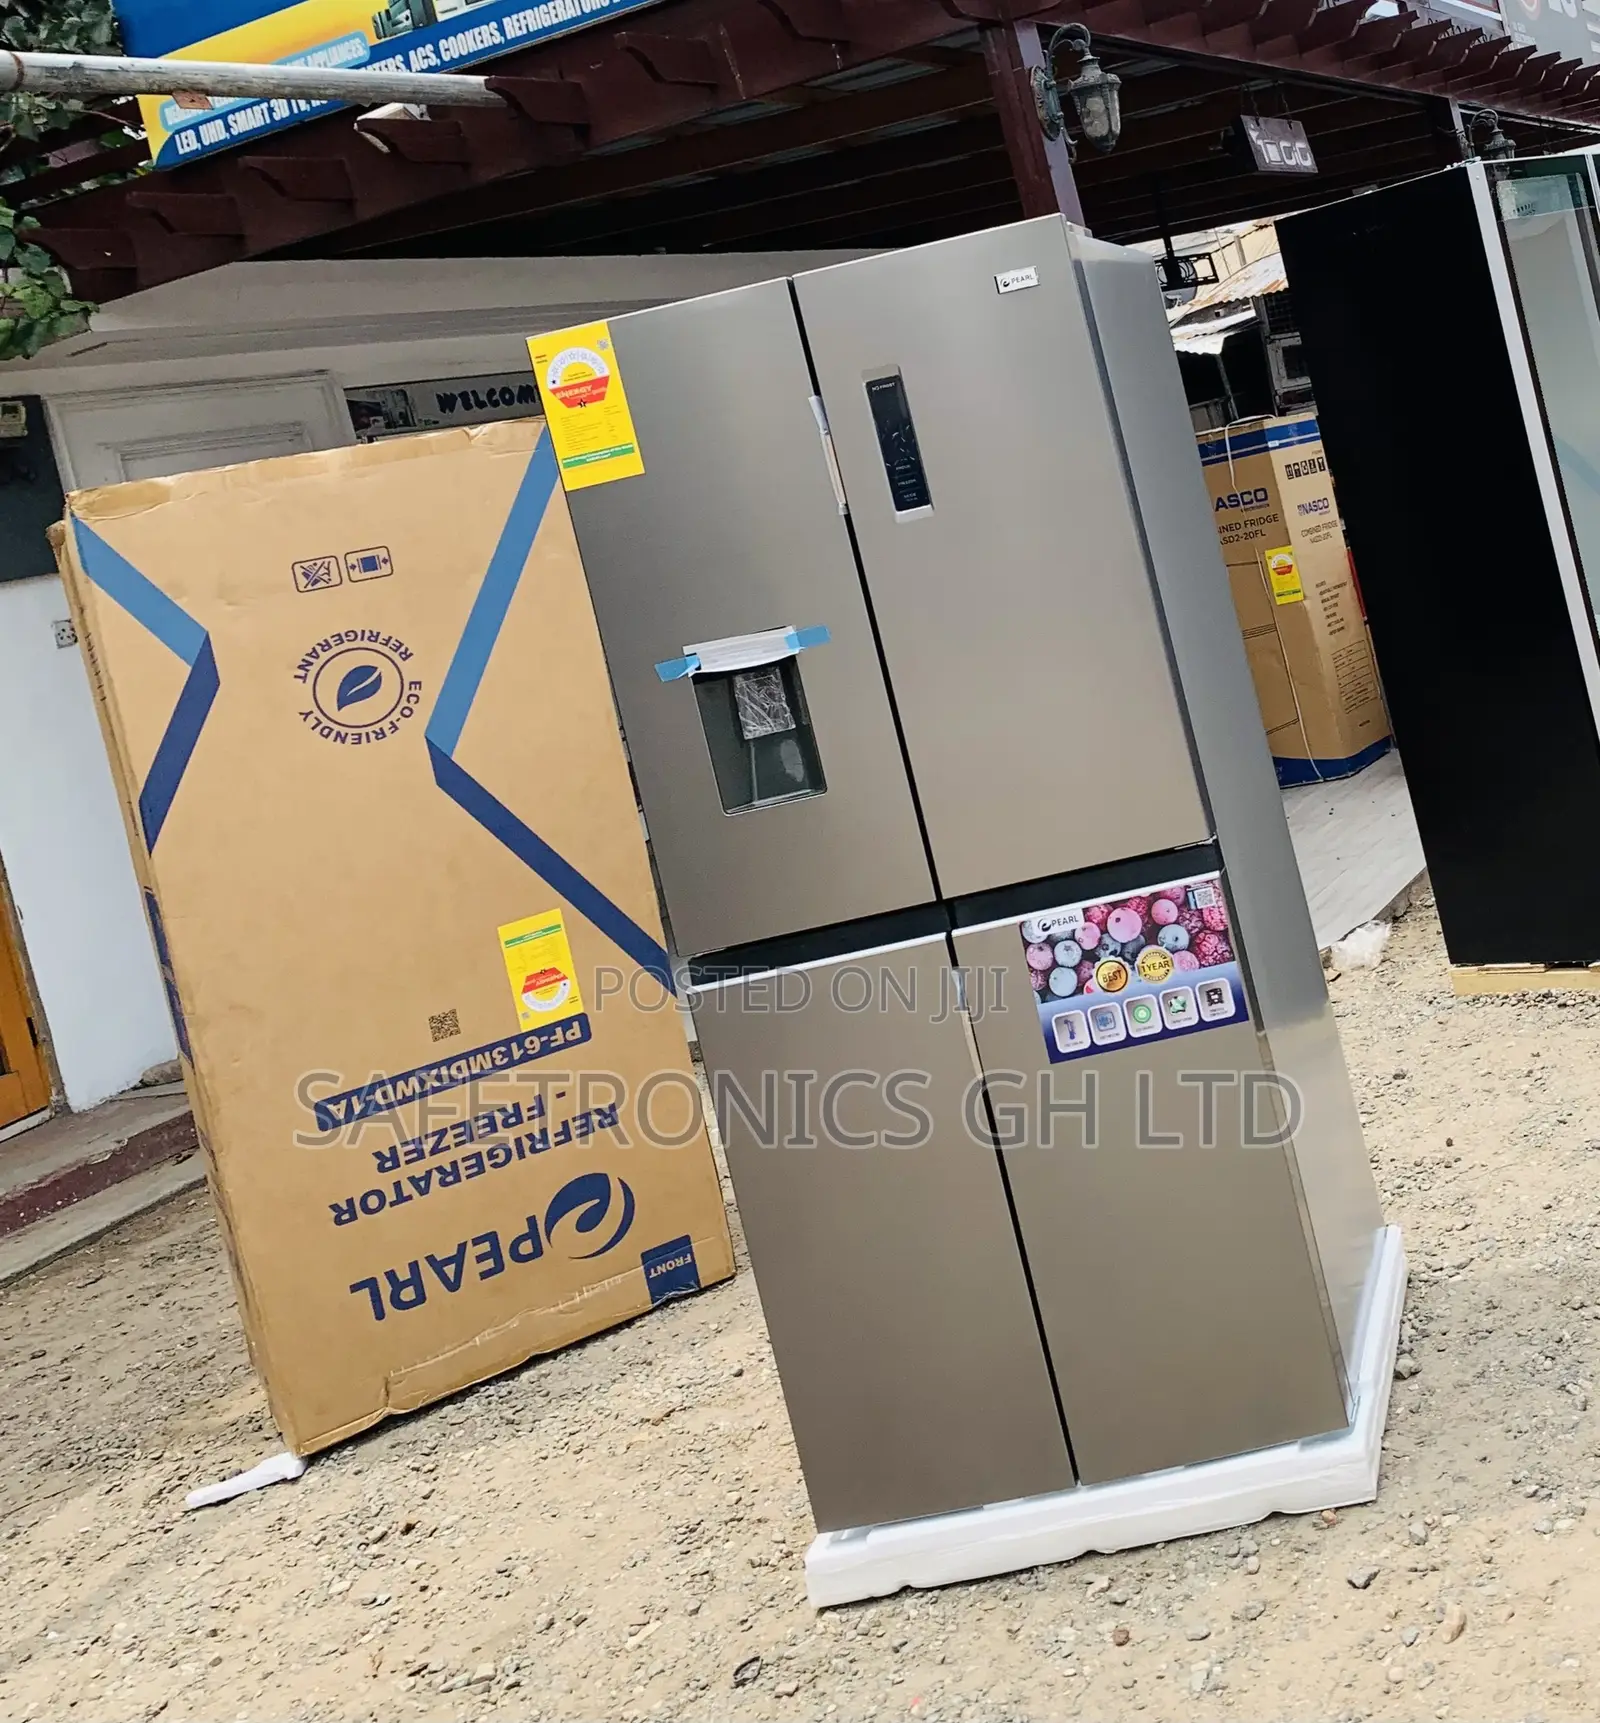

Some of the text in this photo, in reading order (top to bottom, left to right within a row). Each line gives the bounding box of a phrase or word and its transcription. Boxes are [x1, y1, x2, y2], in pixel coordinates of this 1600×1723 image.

[229, 105, 271, 136] SMART
[409, 45, 440, 71] ACS,
[438, 21, 505, 63] COOKERS,
[1011, 274, 1034, 284] PEARL
[436, 384, 540, 414] WELCOM
[1215, 488, 1268, 512] ASCO
[1301, 498, 1330, 515] NASCO
[1244, 513, 1279, 529] FRIDGE
[293, 629, 414, 685] REFRIGERANT
[298, 680, 422, 746] ECO-FRIENDLY
[1051, 914, 1080, 928] PEARL
[1102, 969, 1122, 983] BEST
[1146, 960, 1170, 972] YEAR
[371, 1094, 548, 1174] FREEZER
[328, 1102, 620, 1227] REFRIGERATOR
[349, 1213, 545, 1321] PEARL
[648, 1252, 693, 1280] FRONT
